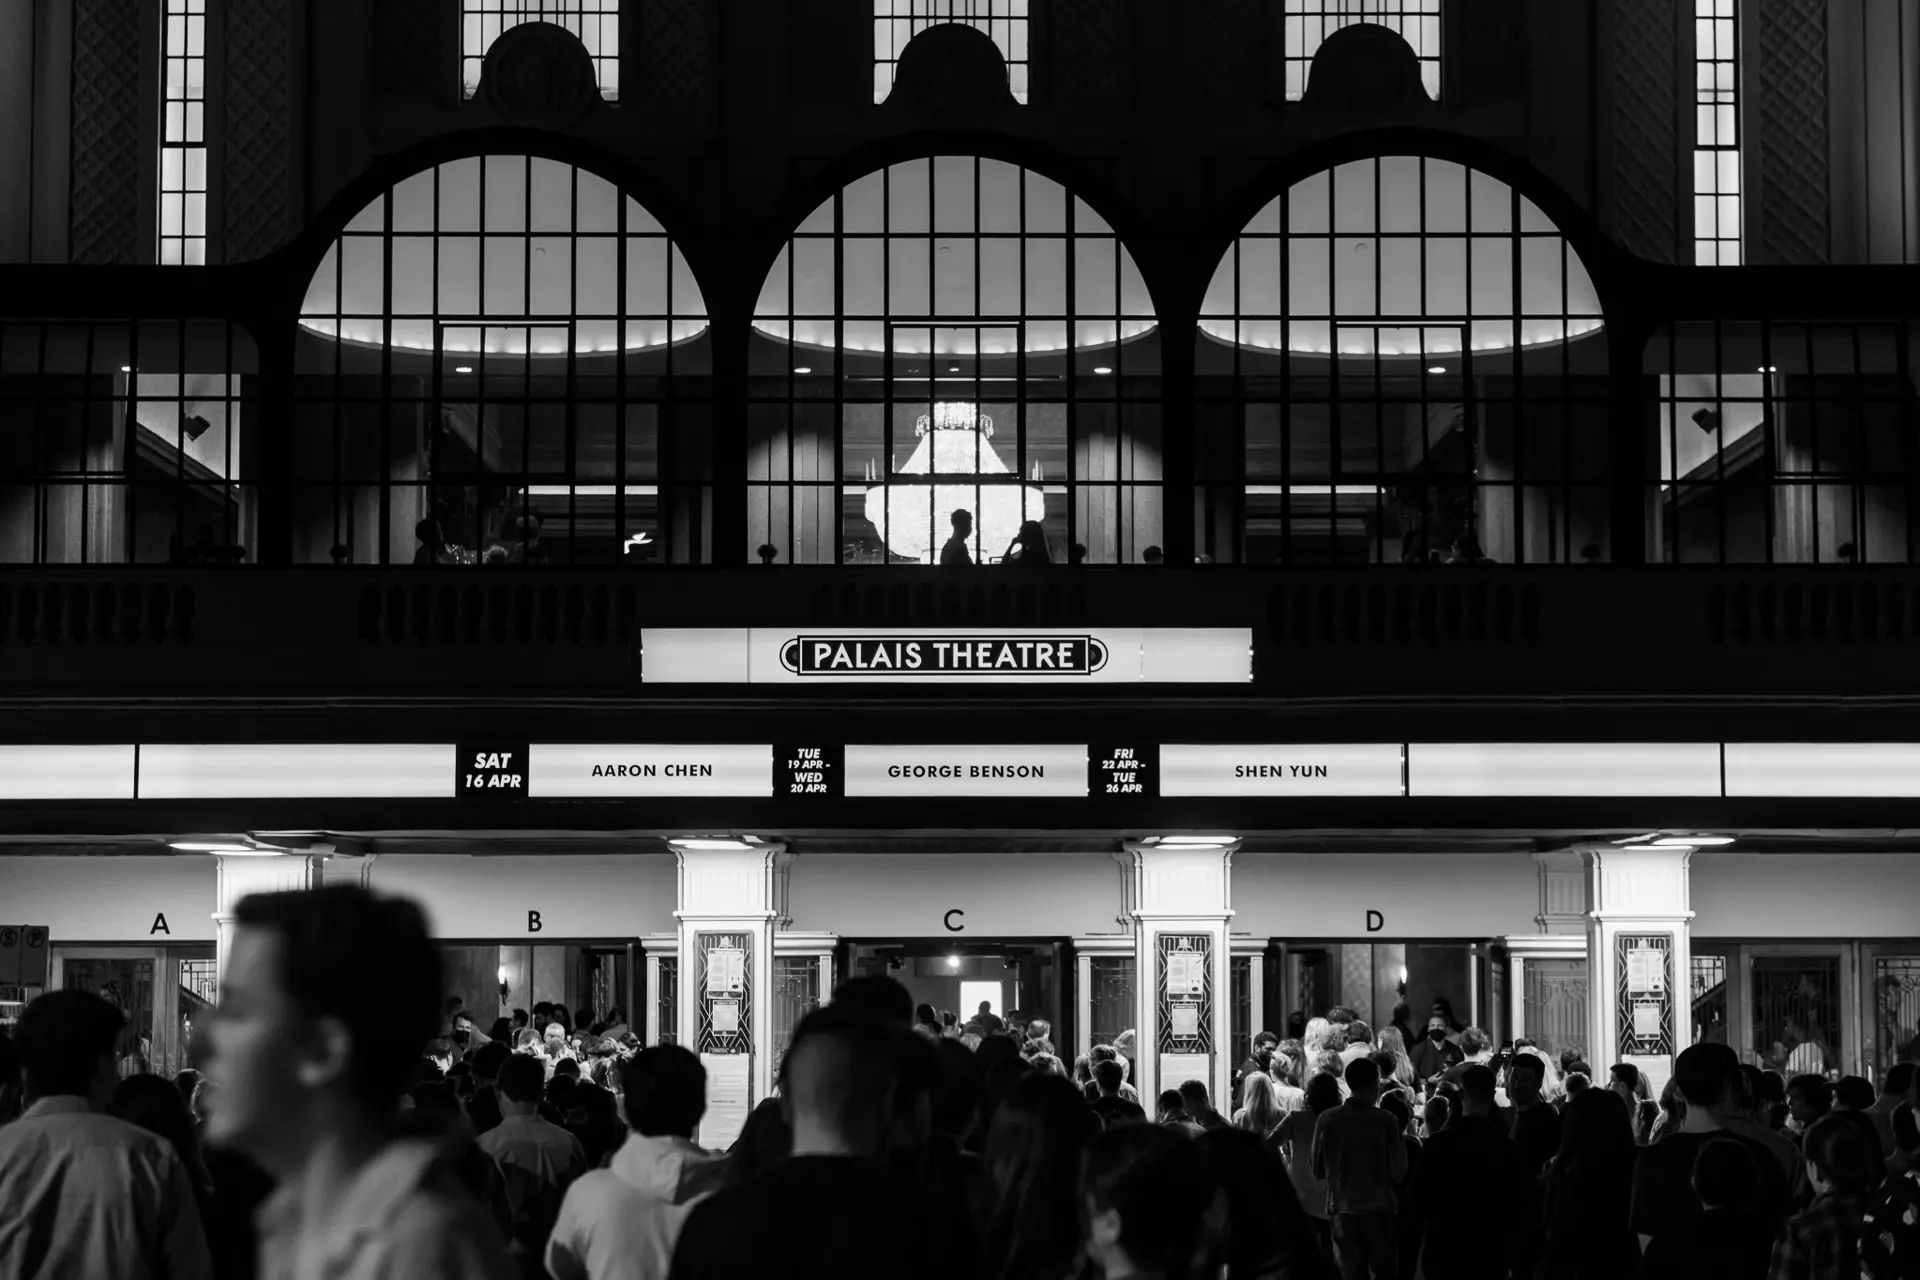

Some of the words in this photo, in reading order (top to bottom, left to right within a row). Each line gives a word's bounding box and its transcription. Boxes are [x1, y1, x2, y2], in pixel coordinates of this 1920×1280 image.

[814, 643, 922, 669] PALAIS
[933, 643, 1075, 669] THEATRE
[797, 748, 821, 759] TUE
[1113, 748, 1134, 759] FRI
[474, 752, 513, 769] SAT
[788, 759, 800, 769] 19
[801, 759, 824, 769] APR
[1102, 759, 1115, 769] 22
[1116, 759, 1139, 769] APR
[591, 764, 656, 777] AARON
[664, 764, 712, 777] CHEN
[888, 765, 962, 778] GEORGE
[969, 765, 1044, 778] BENSON
[1235, 765, 1282, 778] SHEN
[1289, 765, 1327, 778] YUN
[466, 774, 484, 788] 16
[487, 774, 522, 788] APR
[794, 772, 823, 783] WED
[1112, 772, 1136, 783] TUE
[790, 783, 804, 793] 20
[805, 783, 827, 793] APR
[1106, 783, 1119, 793] 26
[1120, 783, 1143, 793] APR
[150, 912, 171, 935] A
[528, 910, 542, 932] B
[943, 908, 965, 932] C
[1366, 909, 1385, 932] D
